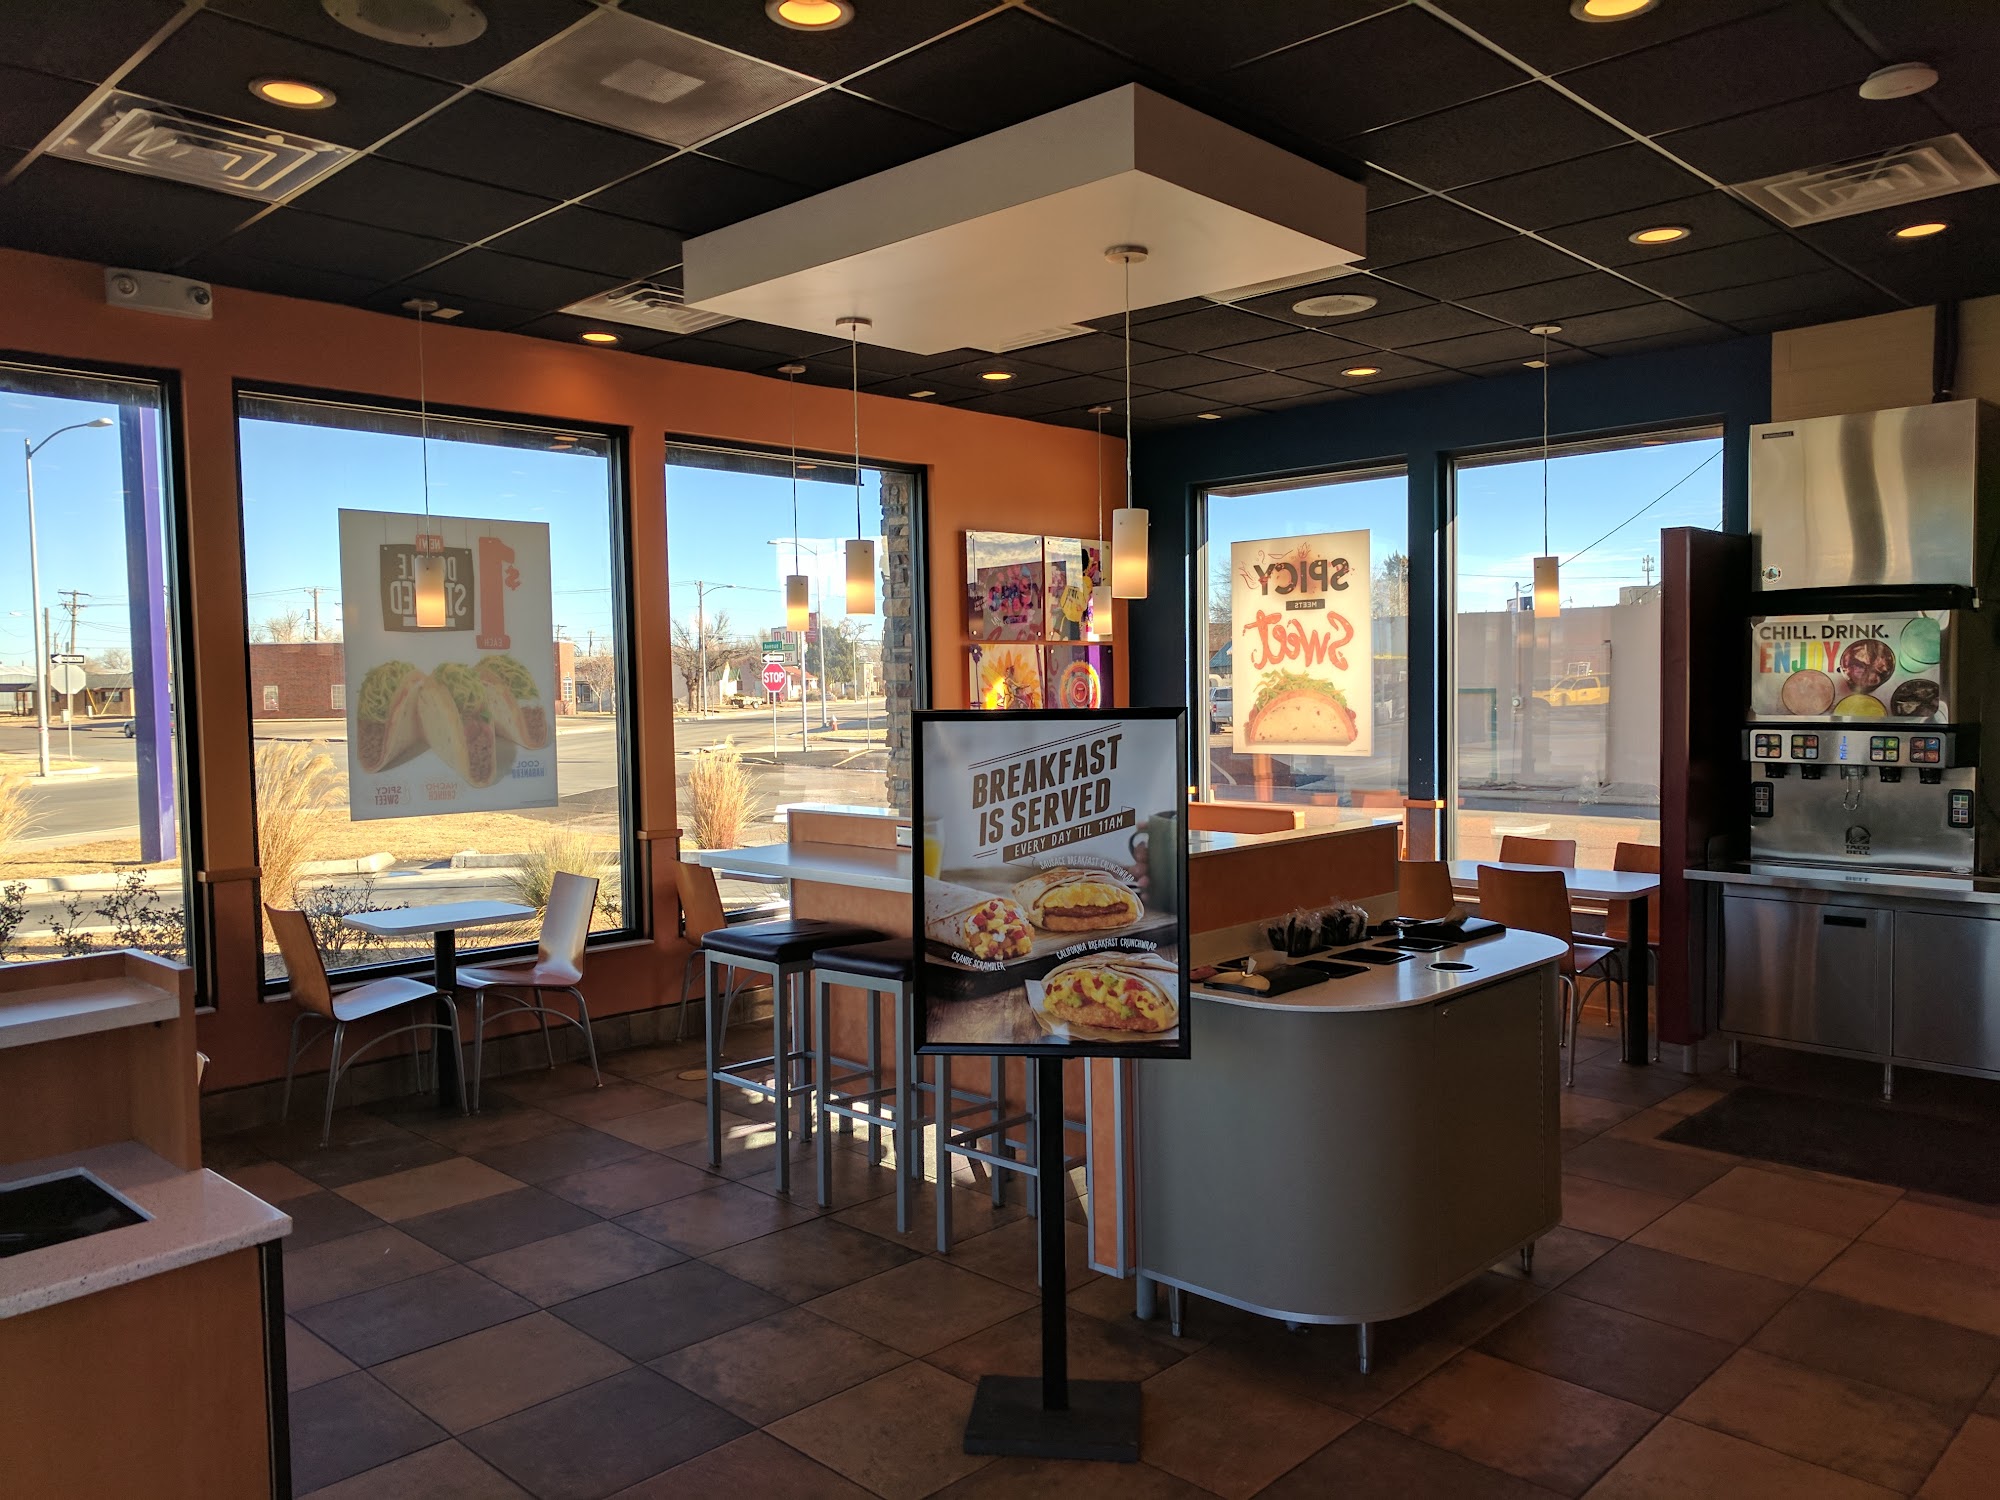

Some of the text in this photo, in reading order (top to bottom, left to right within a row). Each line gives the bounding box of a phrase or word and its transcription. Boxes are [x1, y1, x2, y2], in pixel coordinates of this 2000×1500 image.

[1759, 624, 1889, 640] CHILL. DRINK.
[1759, 640, 1842, 674] ENJOY.
[763, 671, 785, 683] STOP
[972, 733, 1123, 810] BREAKFAST
[979, 777, 1111, 847] IS SERVED
[1014, 837, 1046, 857] EVERY
[1051, 830, 1072, 845] DAY
[1098, 814, 1123, 833] 11AM
[1067, 855, 1099, 867] BREAKFAST
[1056, 937, 1158, 960] CALIFORNIA BREAKFAST CRUNCHWRAP
[973, 958, 1007, 972] SCRAMBLER
